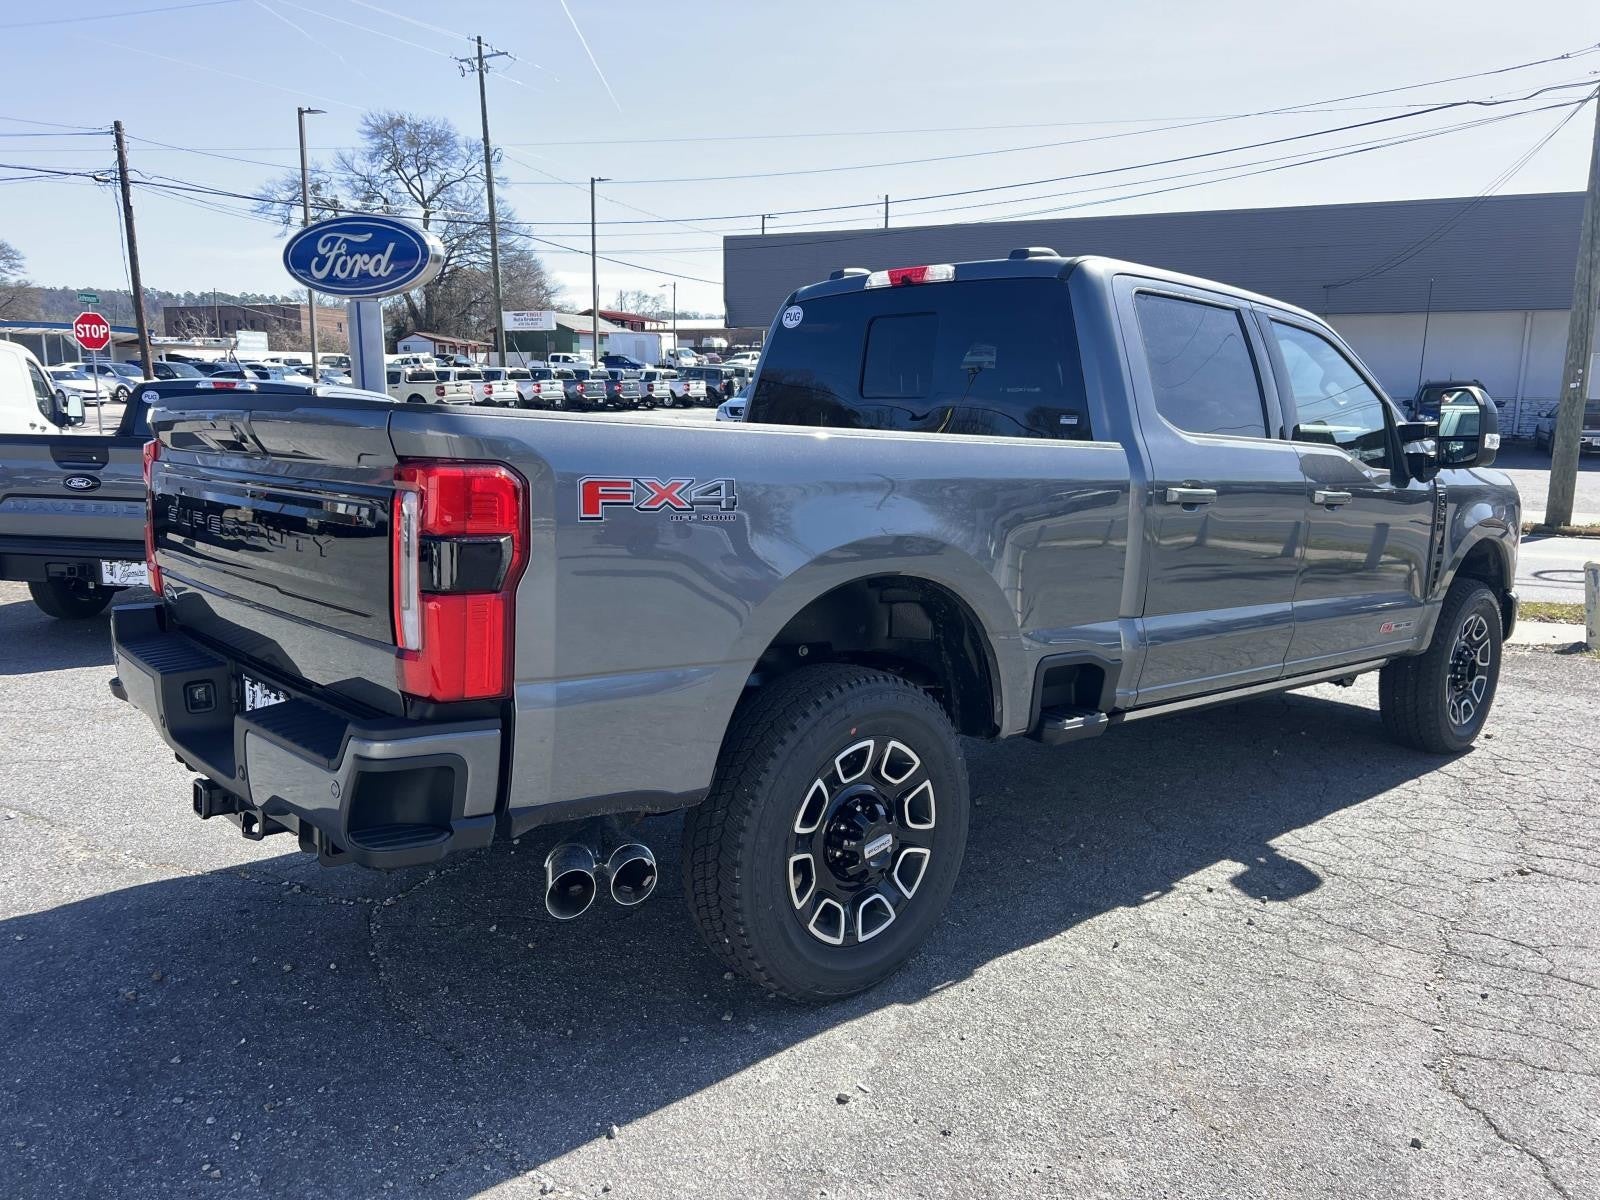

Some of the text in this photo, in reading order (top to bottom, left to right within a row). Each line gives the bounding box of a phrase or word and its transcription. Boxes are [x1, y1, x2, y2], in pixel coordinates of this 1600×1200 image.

[311, 232, 396, 279] Ford
[785, 312, 801, 322] PUG
[76, 324, 108, 338] STOP
[70, 479, 88, 488] Ford
[577, 475, 738, 522] FX4
[8, 501, 140, 515] MAVERIC
